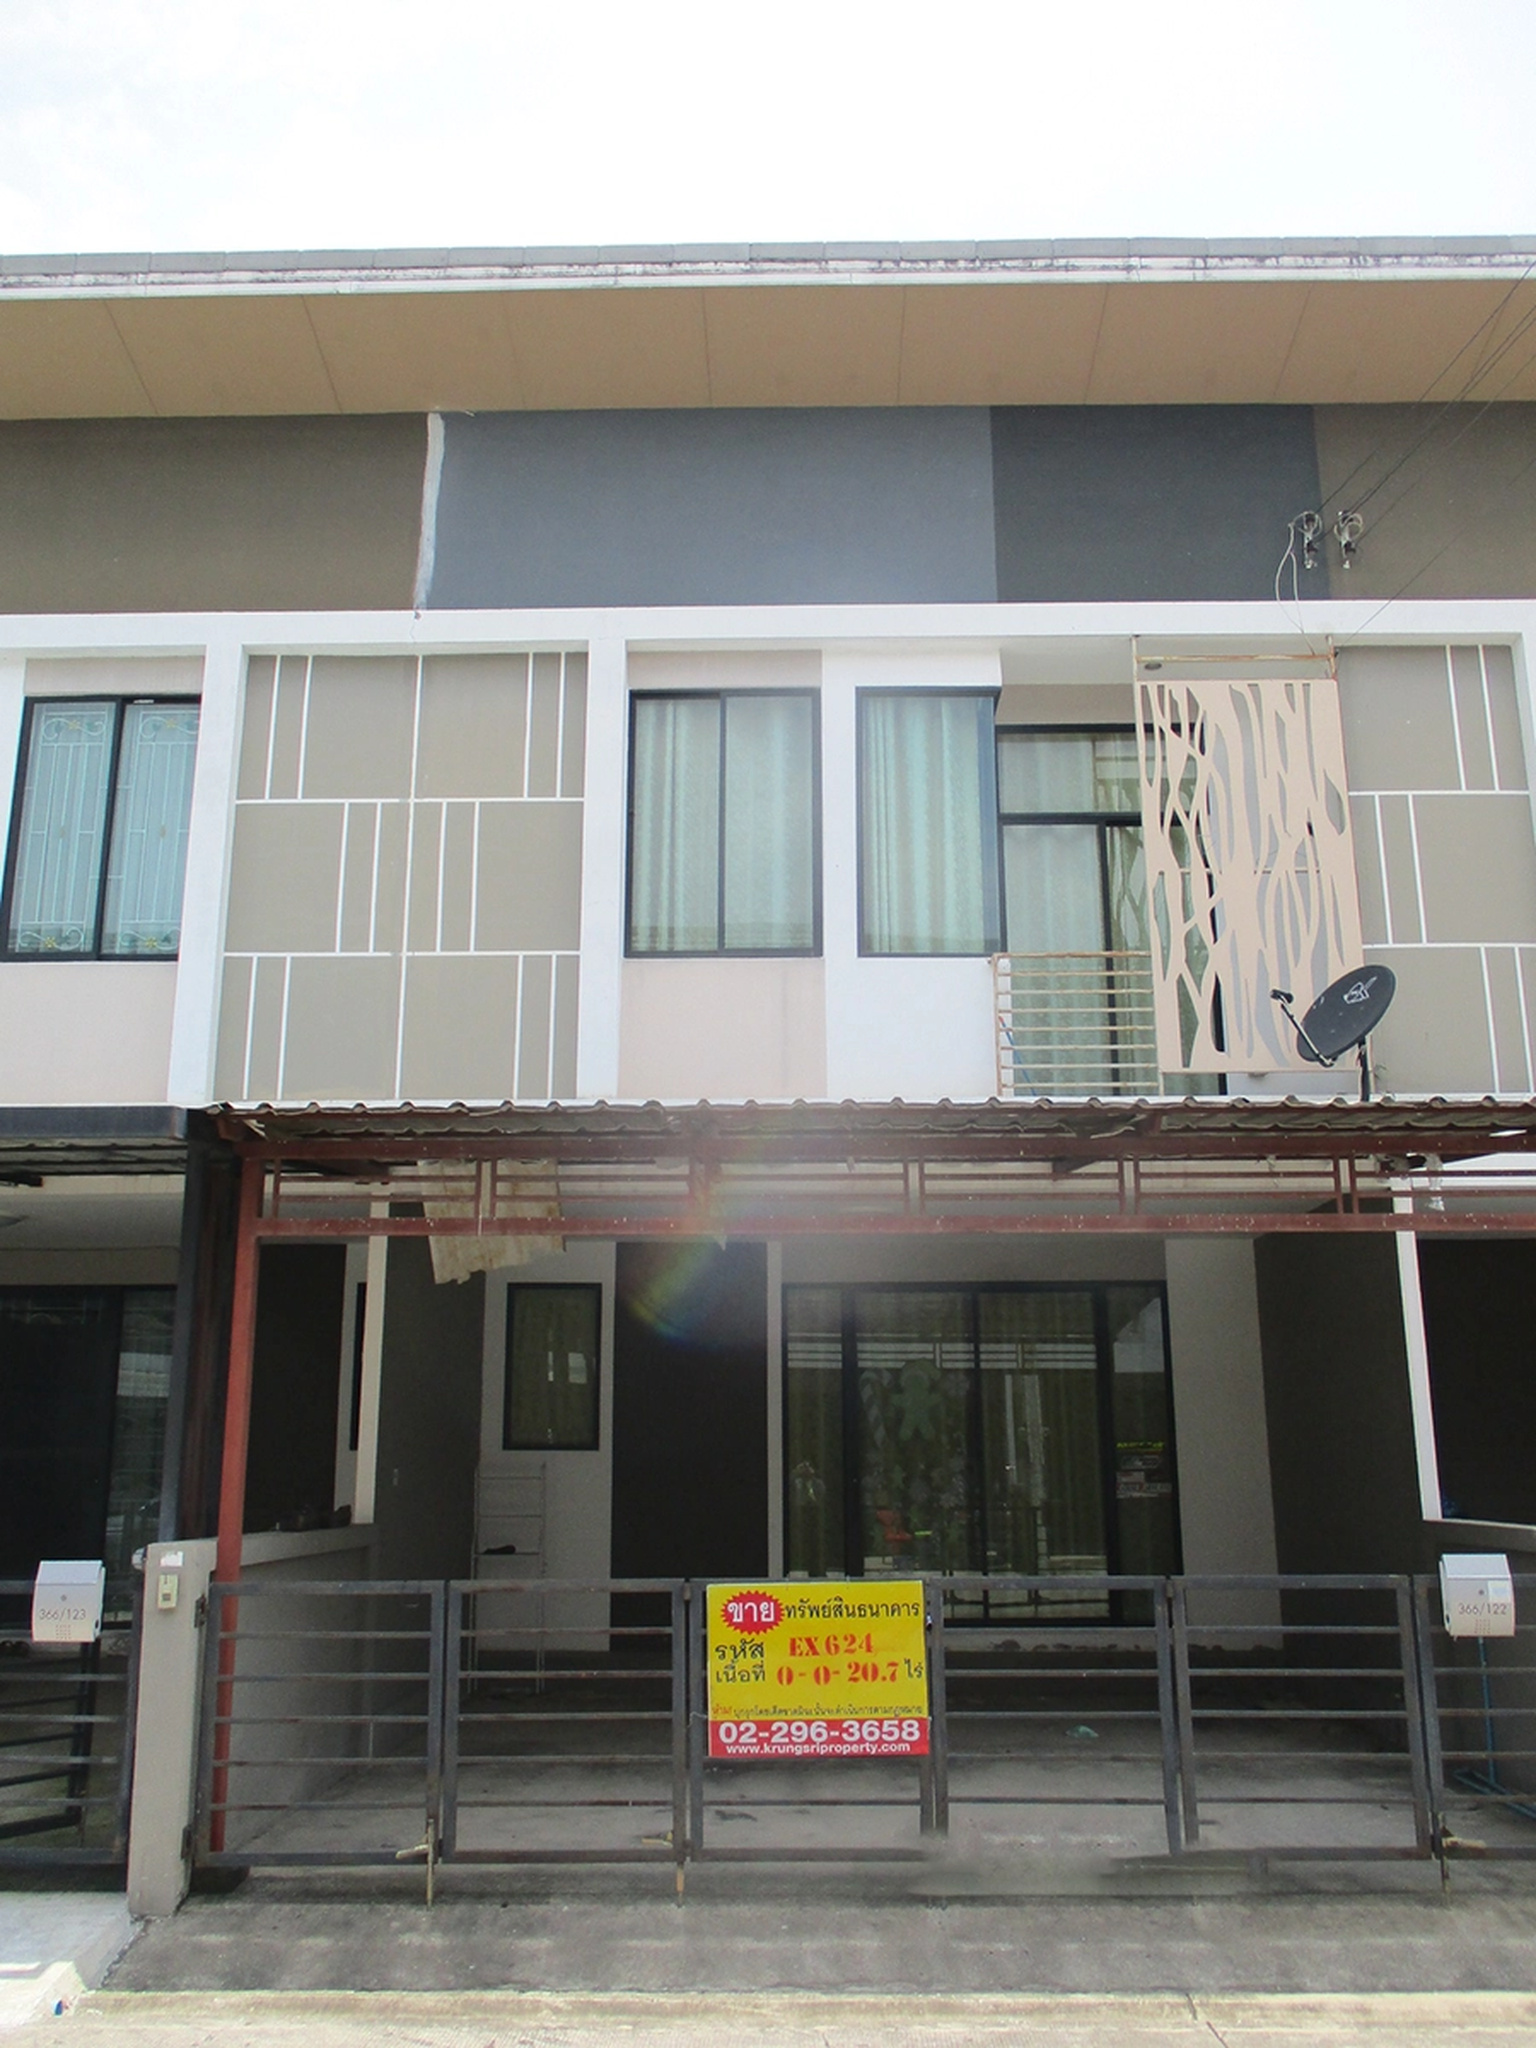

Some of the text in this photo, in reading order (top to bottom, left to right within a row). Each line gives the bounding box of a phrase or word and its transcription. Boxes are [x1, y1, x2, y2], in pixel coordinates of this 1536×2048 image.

[39, 1608, 86, 1621] 366/123
[727, 1596, 920, 1622] ขาย ทรัพย์สินธนาคาร
[1459, 1603, 1507, 1615] 366/122
[715, 1639, 765, 1660] รหัส
[715, 1658, 766, 1683] เนื้อที่
[718, 1719, 921, 1744] 02-296-3658
[726, 1741, 911, 1756] www.krungsriproperty.com
